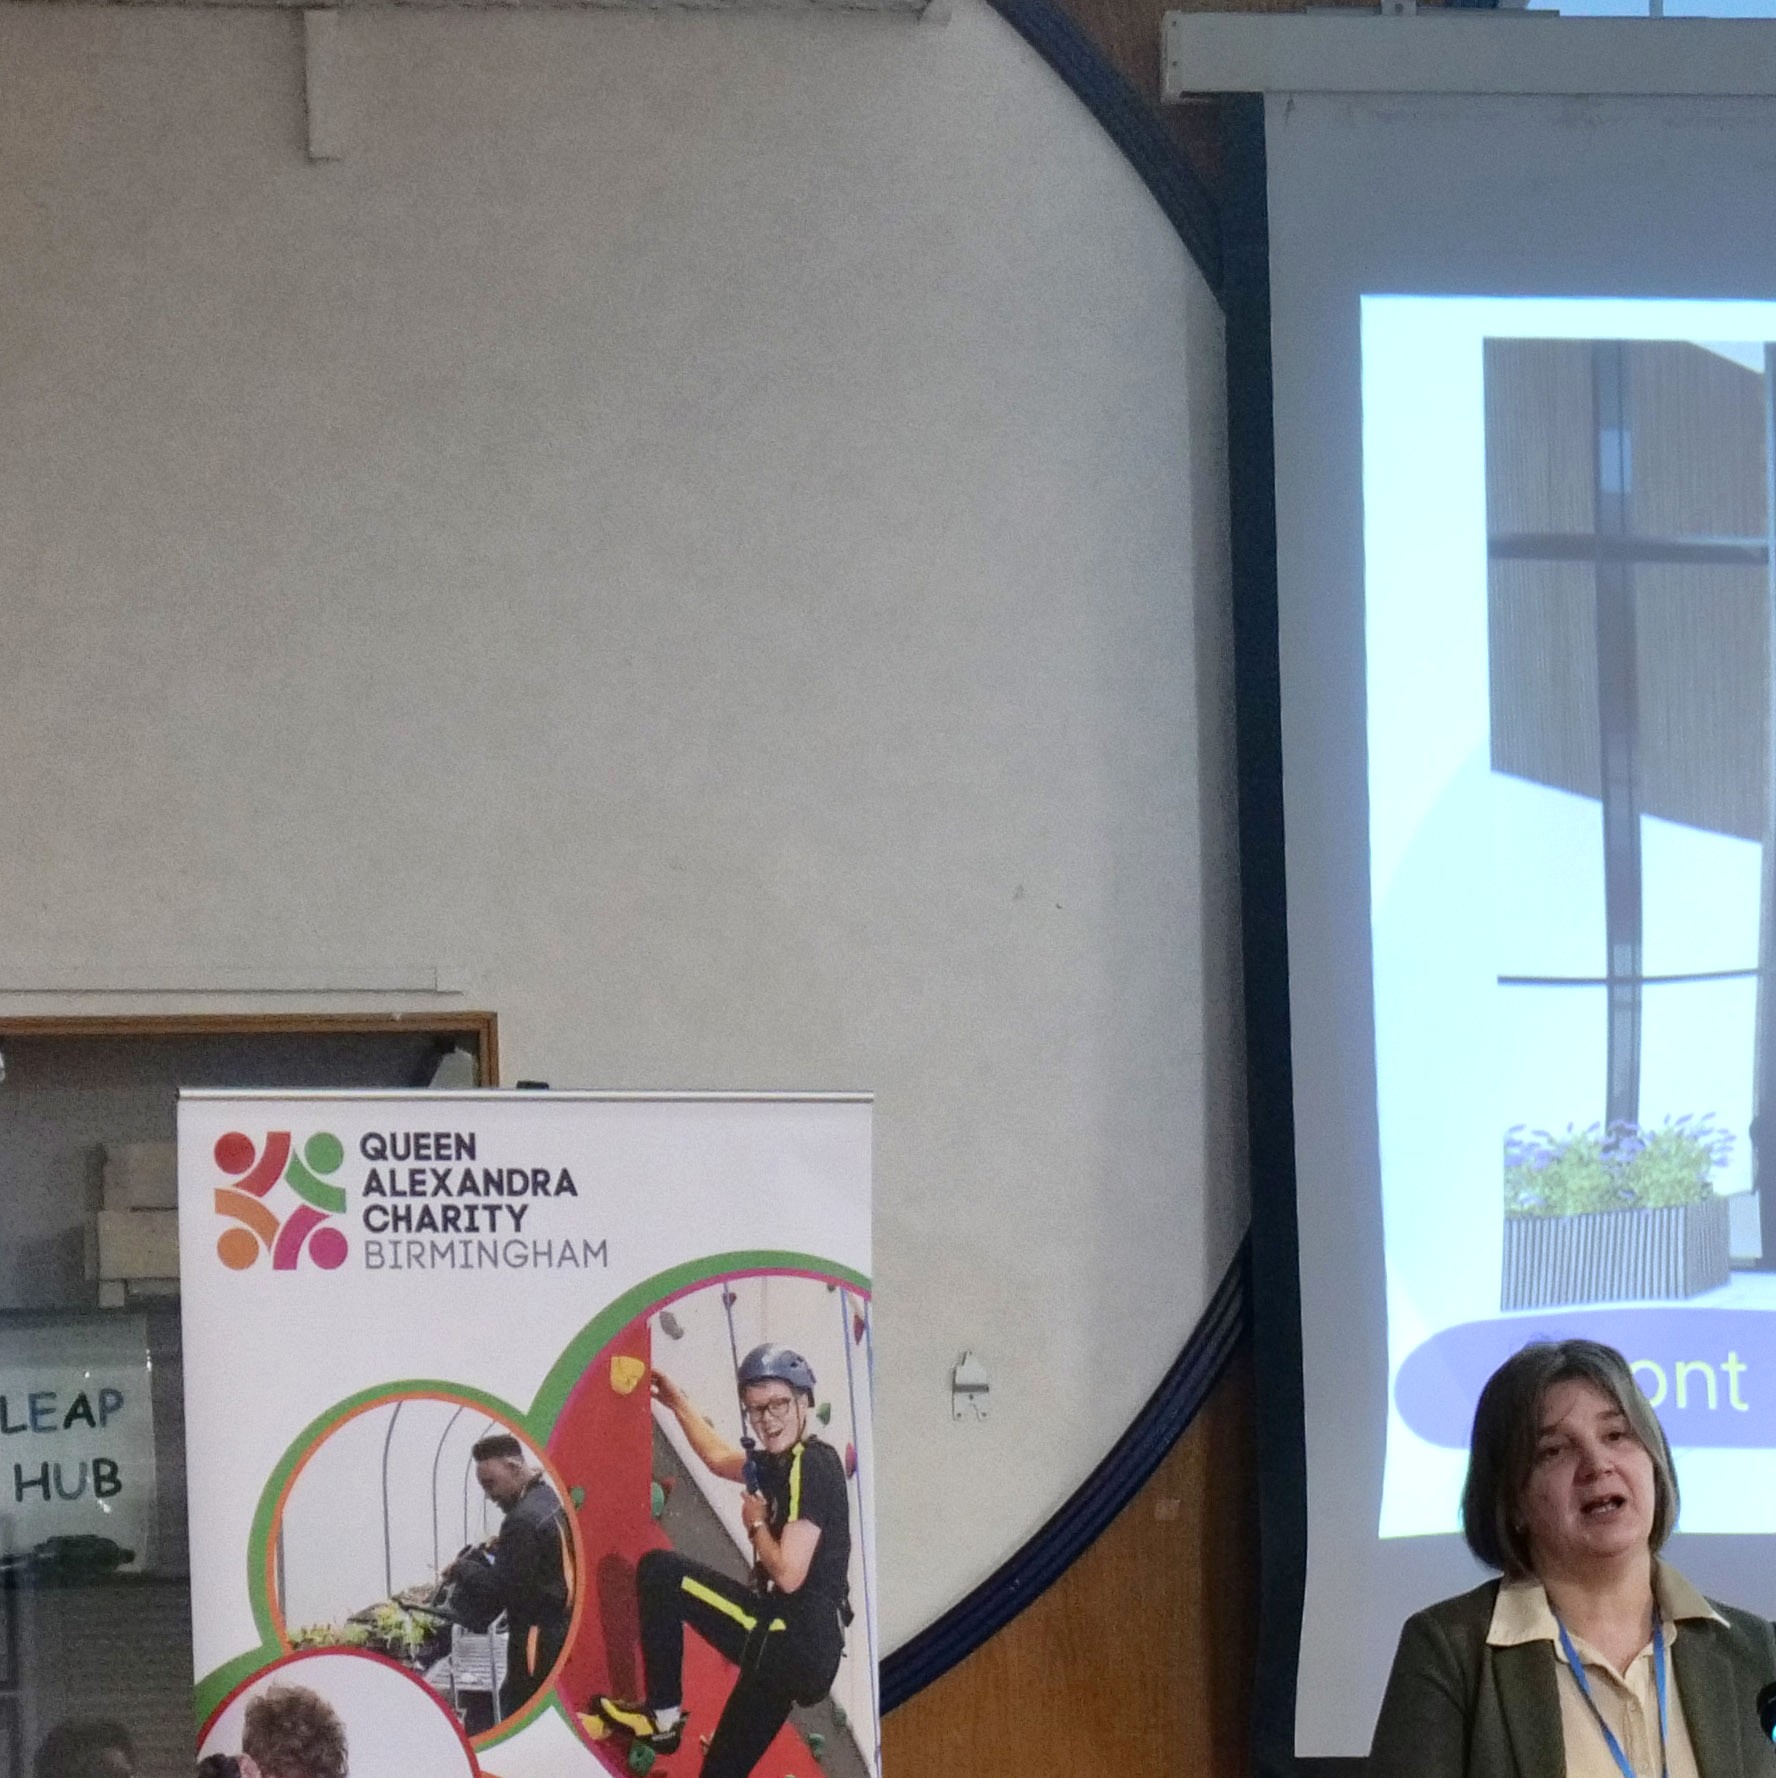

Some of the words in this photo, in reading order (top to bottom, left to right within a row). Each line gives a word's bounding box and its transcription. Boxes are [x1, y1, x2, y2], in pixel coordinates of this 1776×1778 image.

[359, 1132, 477, 1162] QUEEN
[362, 1167, 579, 1198] ALEXANDRA
[362, 1203, 529, 1234] CHARITY
[364, 1238, 608, 1270] BIRMINGHAM
[1629, 1350, 1750, 1413] ont
[0, 1388, 125, 1434] LEAP
[13, 1457, 123, 1503] HUB
